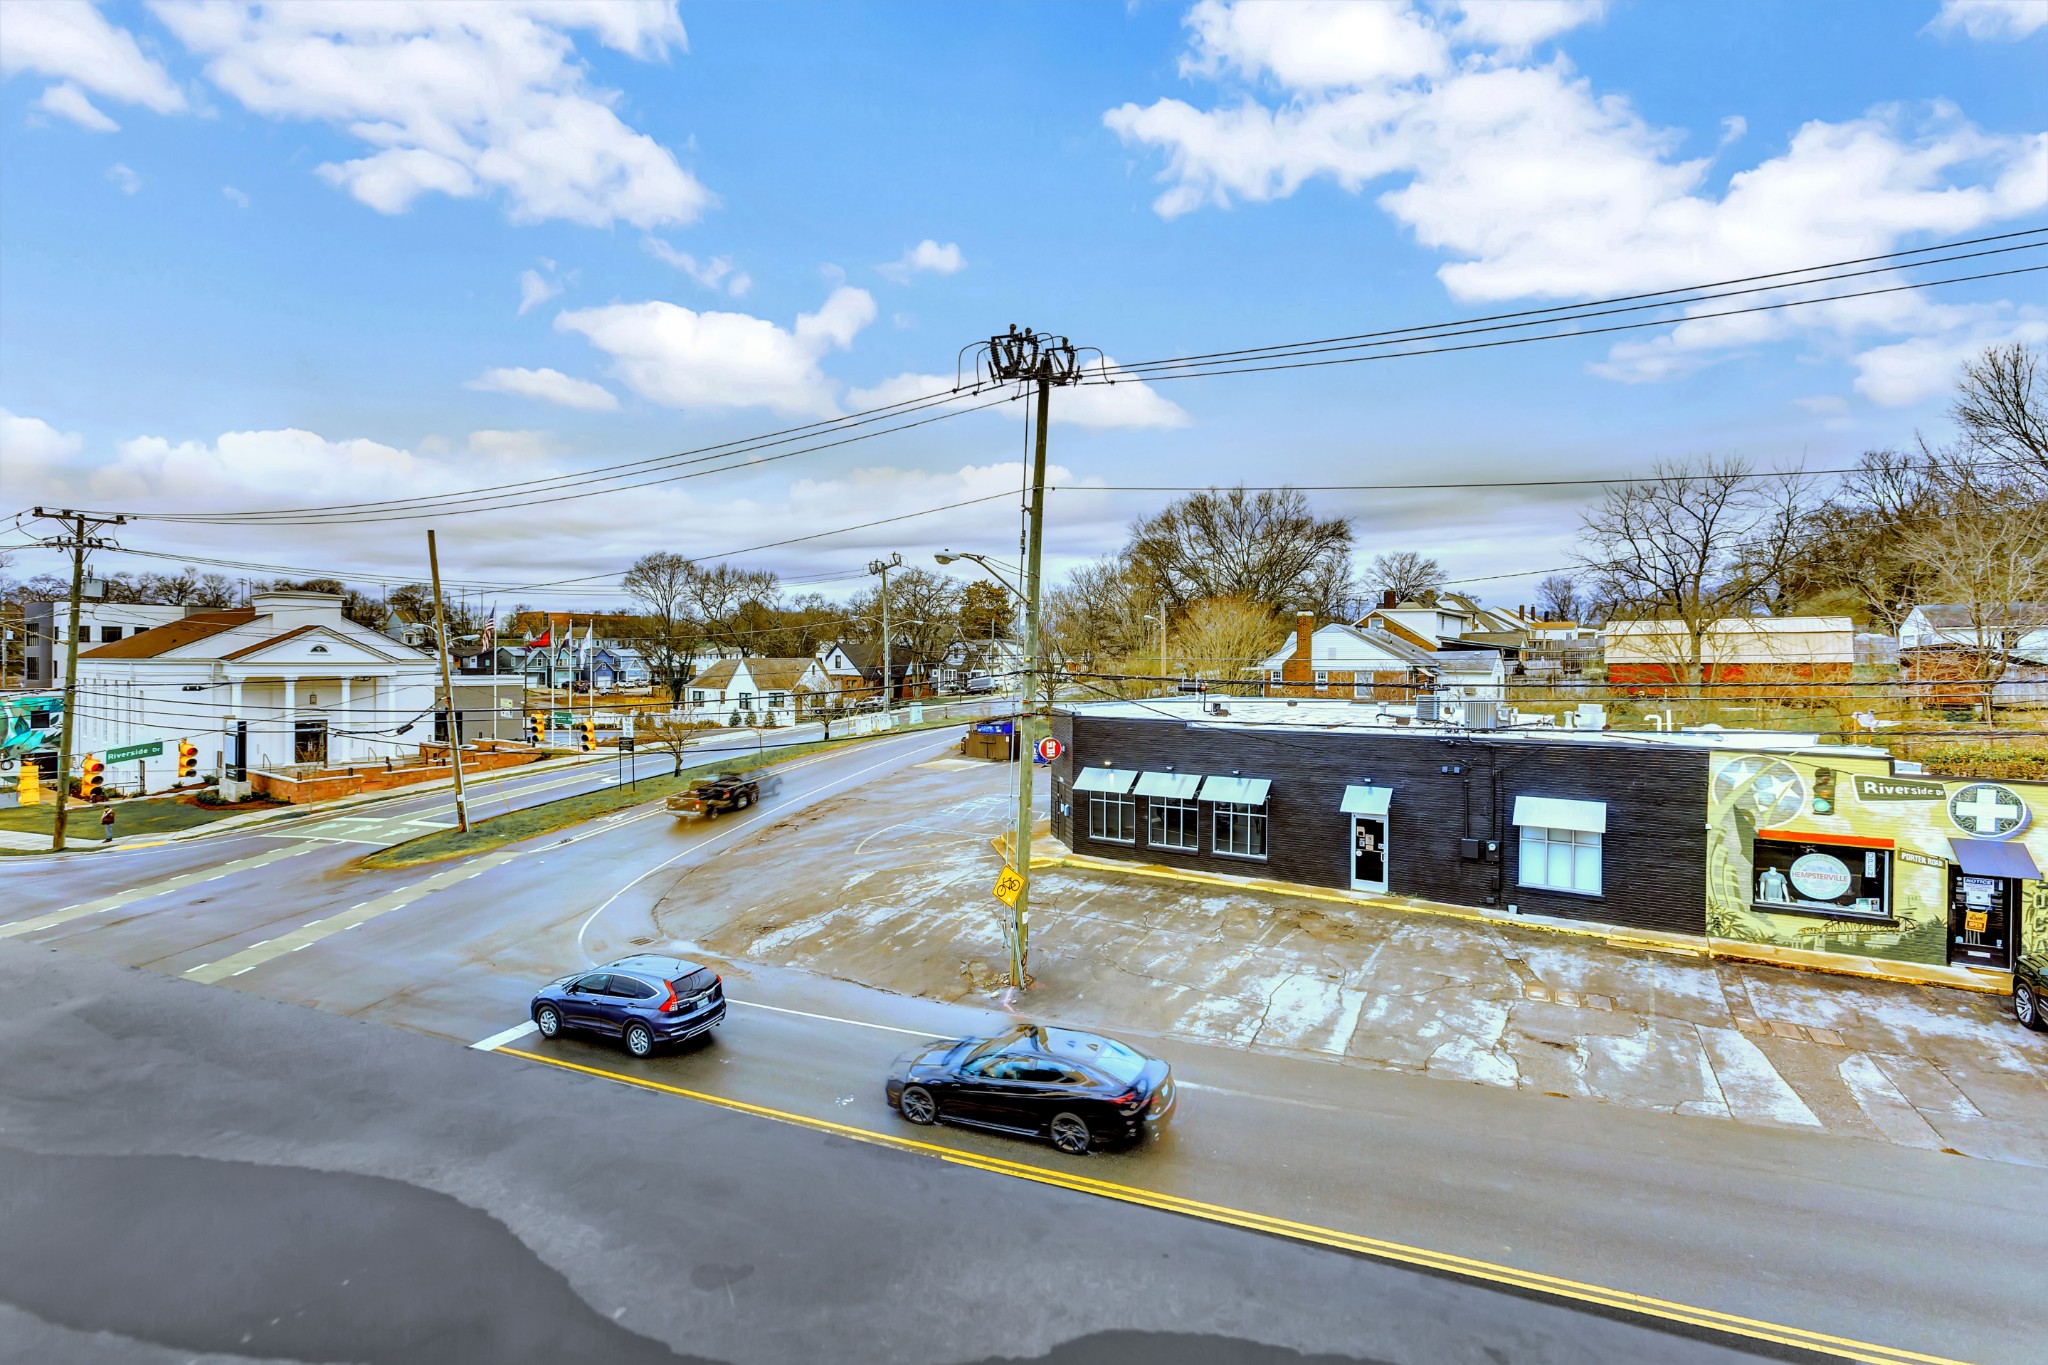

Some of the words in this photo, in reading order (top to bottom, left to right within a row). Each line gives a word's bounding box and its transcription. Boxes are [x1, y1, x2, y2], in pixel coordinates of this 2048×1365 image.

[108, 748, 148, 760] Riverside
[1863, 781, 1933, 795] Riverside
[1901, 851, 1926, 864] PORTER
[1927, 857, 1943, 867] ROAD
[1792, 870, 1848, 882] HEMPSTERVILLE
[1966, 878, 1991, 886] NOTICE
